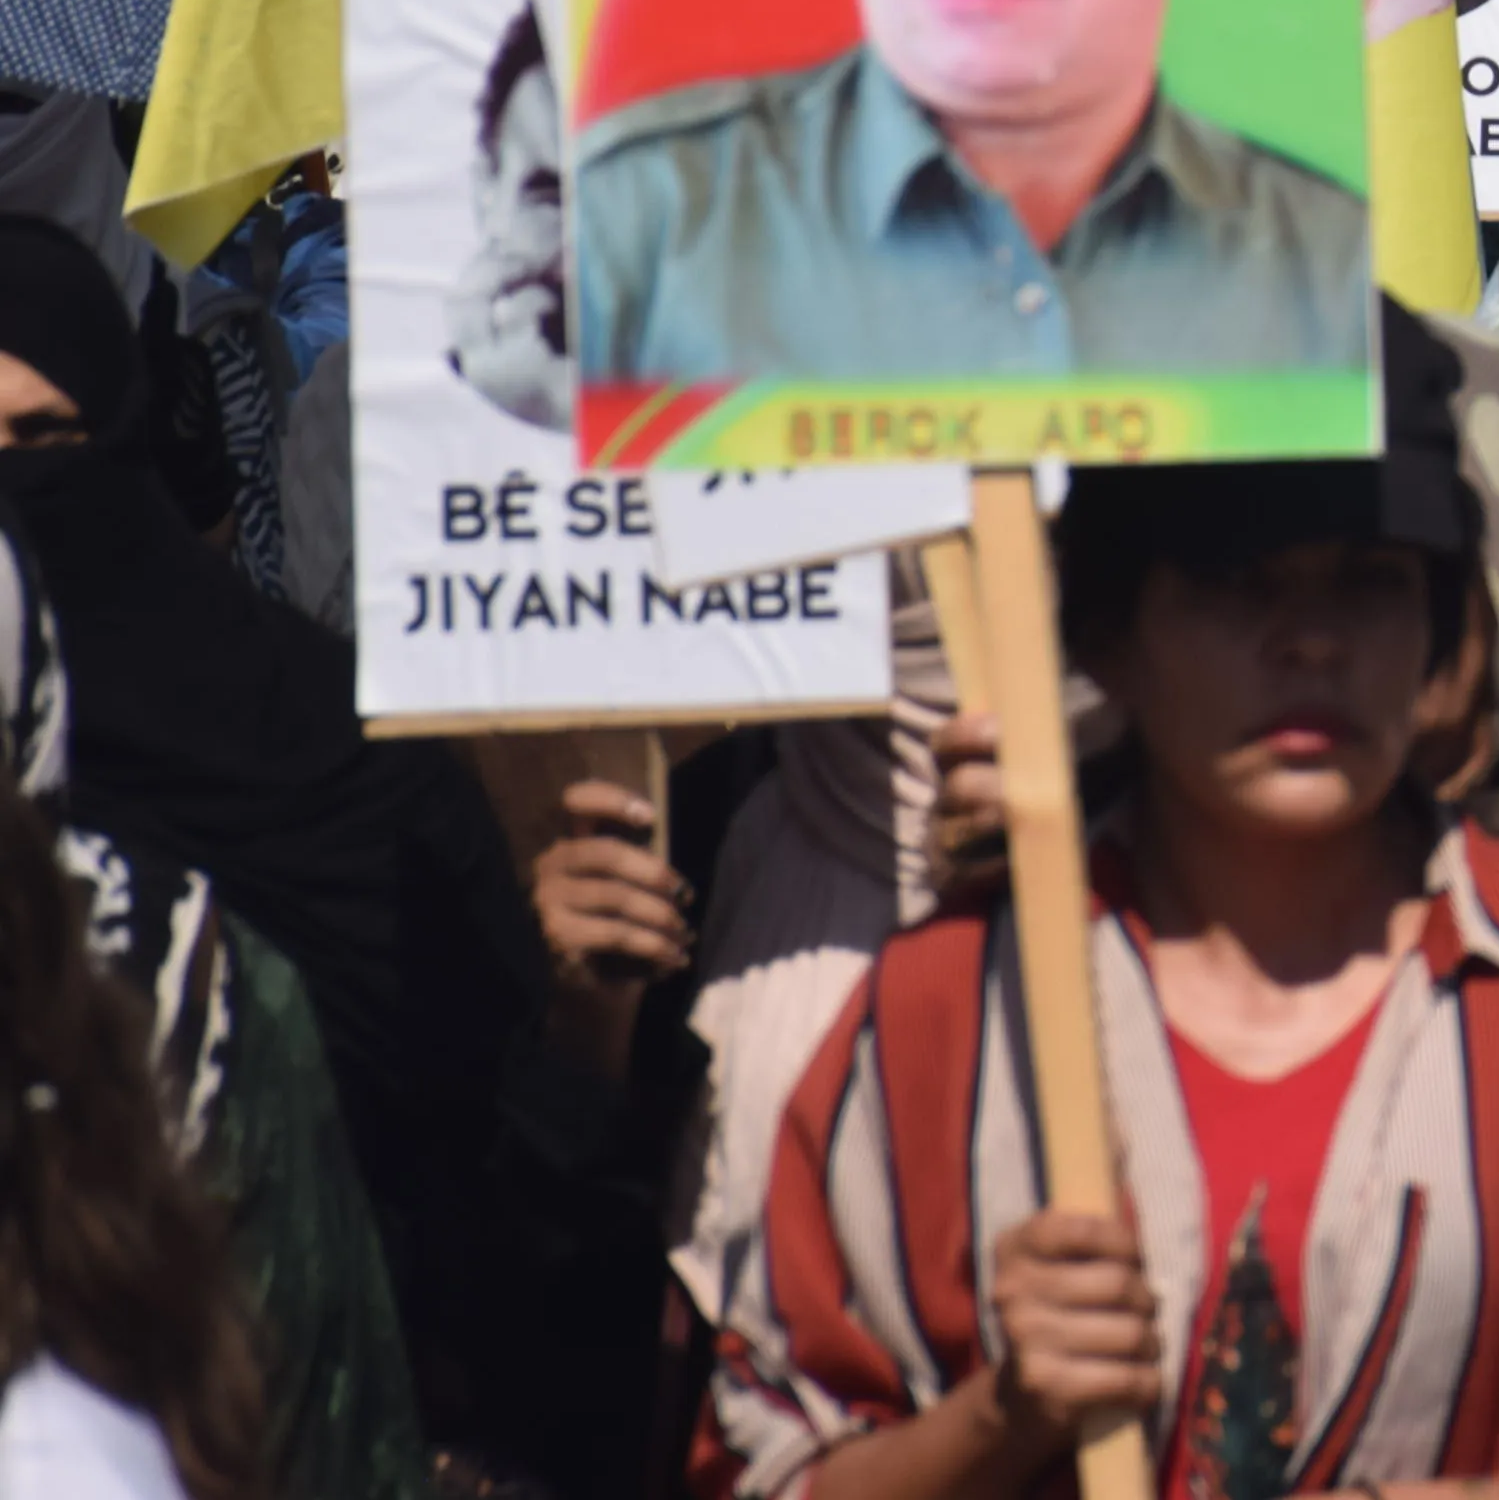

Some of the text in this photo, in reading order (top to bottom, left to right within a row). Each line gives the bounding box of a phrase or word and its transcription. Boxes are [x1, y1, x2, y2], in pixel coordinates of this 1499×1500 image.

[441, 470, 539, 543] BÊ
[404, 562, 838, 634] JIYAN NABE
